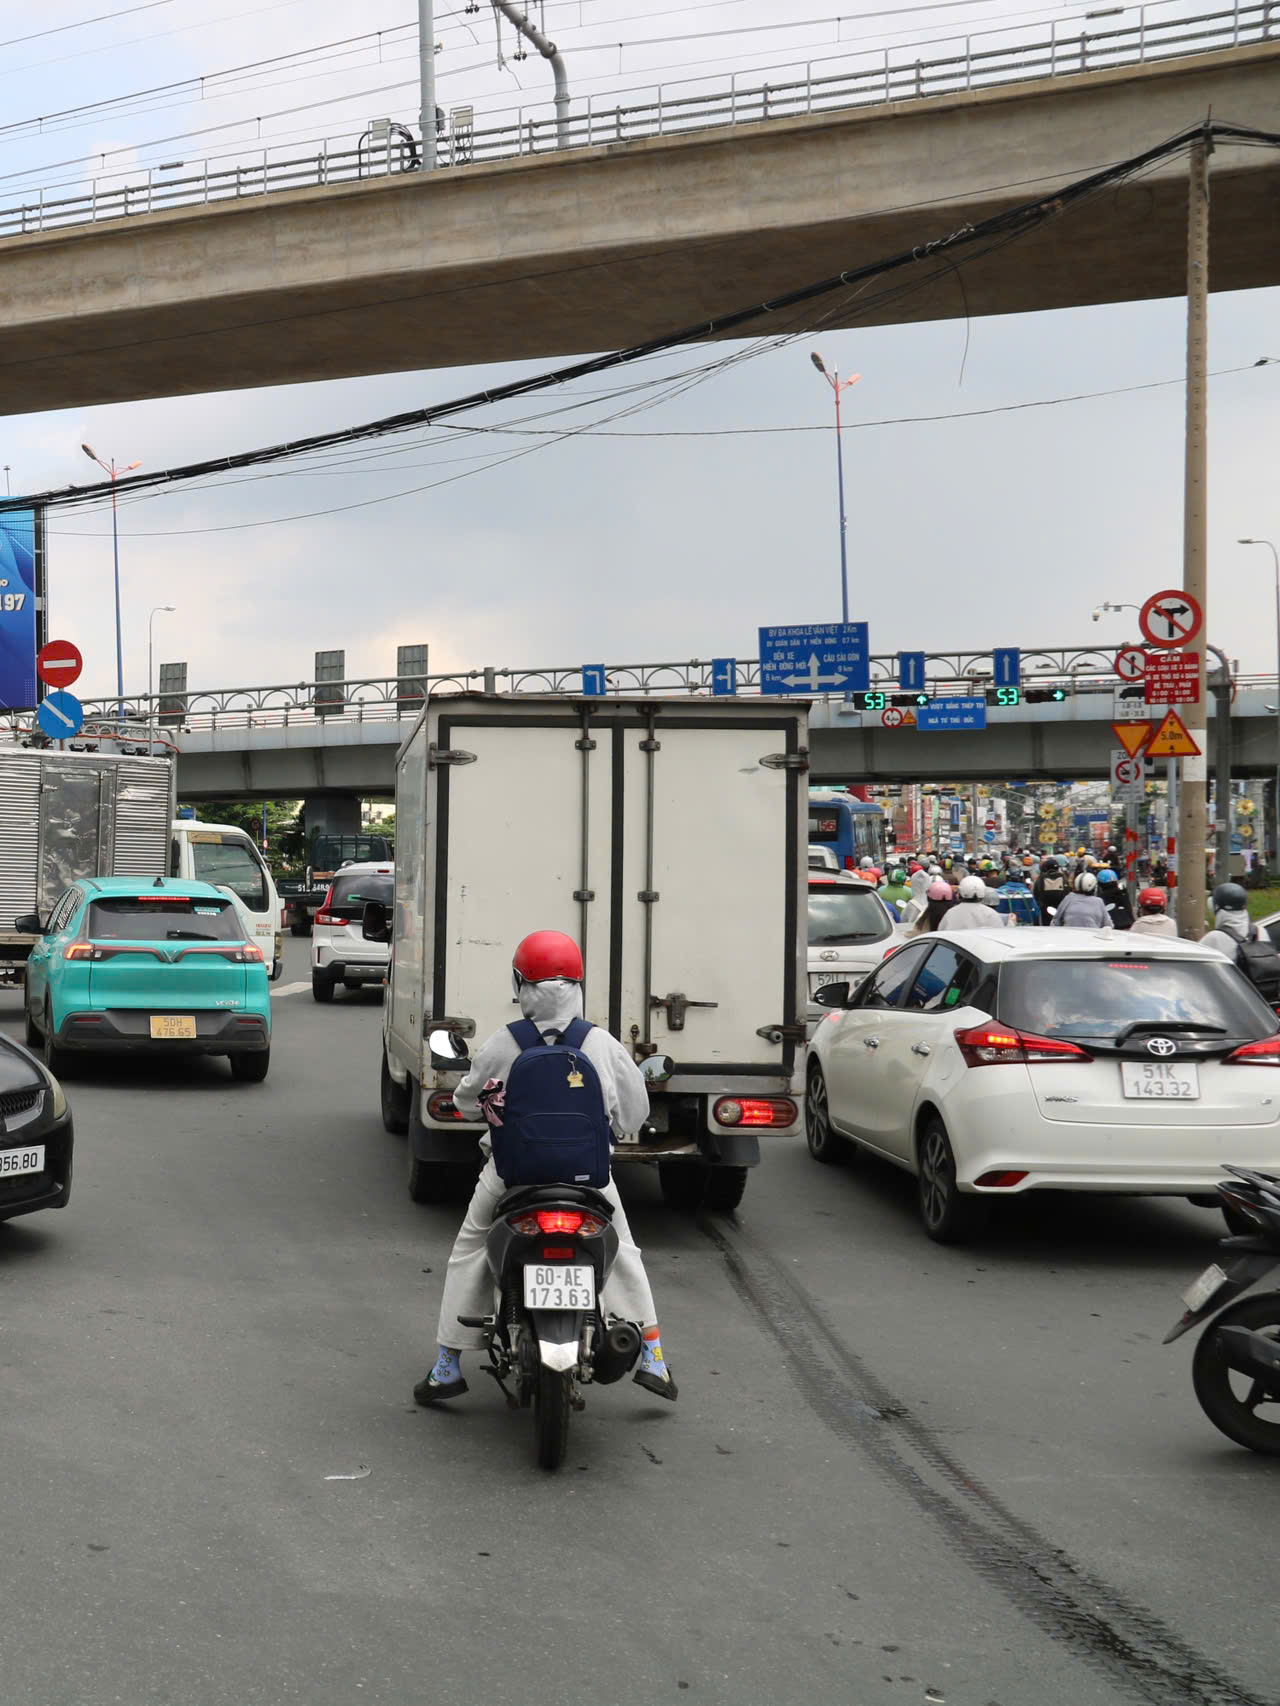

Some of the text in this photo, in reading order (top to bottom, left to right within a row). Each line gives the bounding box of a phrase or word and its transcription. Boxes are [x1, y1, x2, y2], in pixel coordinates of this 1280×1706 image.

[864, 692, 885, 710] 53
[996, 687, 1019, 705] 53
[1142, 1063, 1176, 1079] 51K
[1133, 1080, 1192, 1097] 143.32
[535, 1267, 583, 1287] 60-AE
[530, 1287, 591, 1307] 173.63
